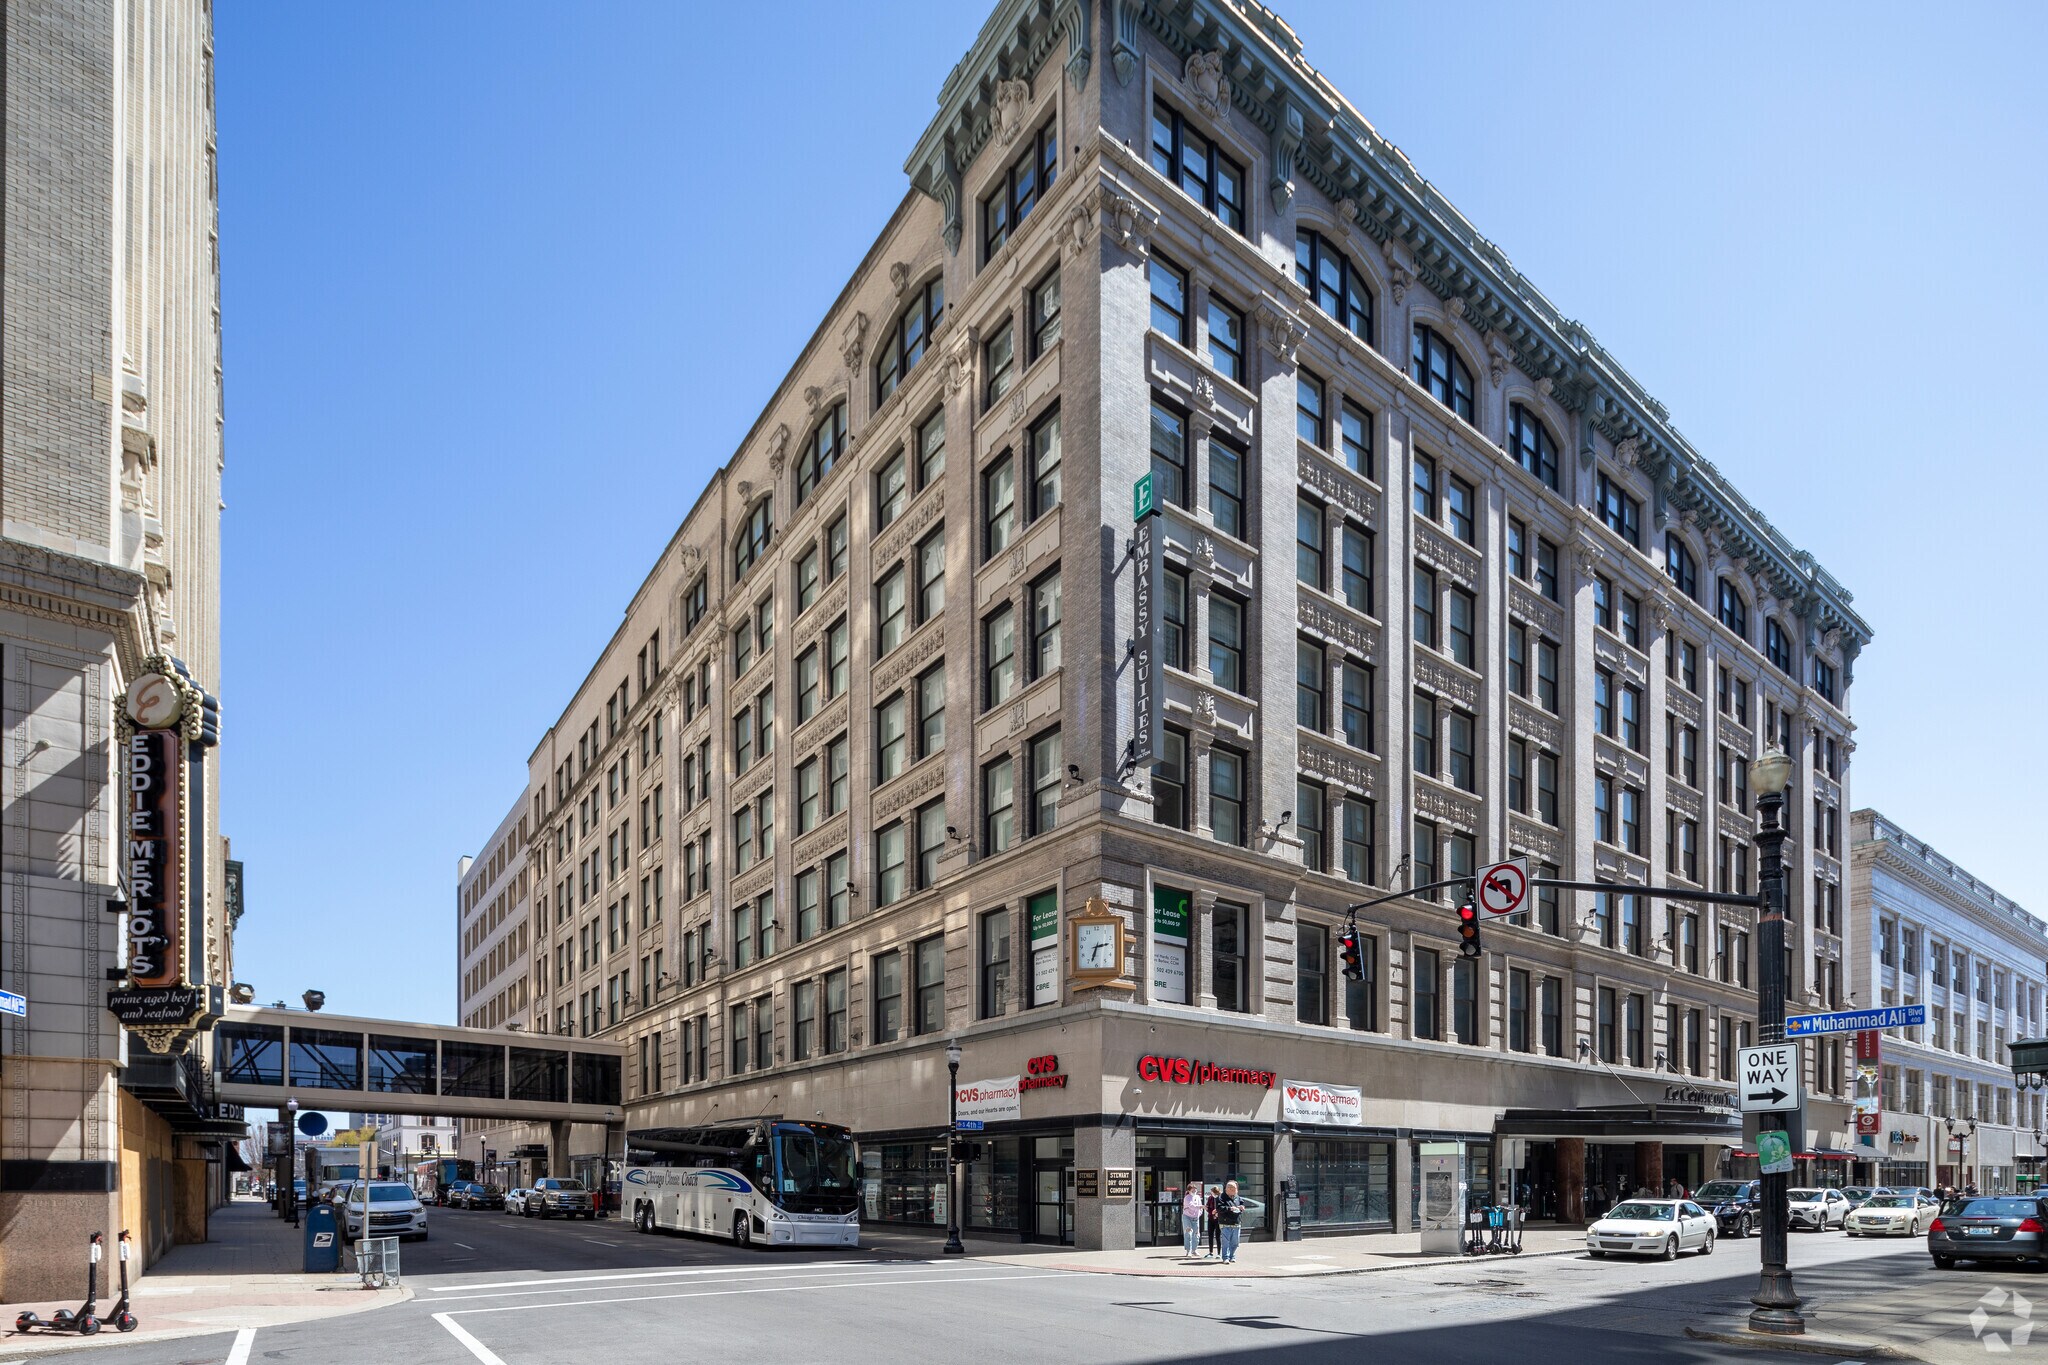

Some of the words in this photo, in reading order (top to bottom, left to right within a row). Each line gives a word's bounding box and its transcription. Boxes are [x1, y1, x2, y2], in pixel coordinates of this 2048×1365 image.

[1136, 525, 1150, 638] EMBASSY
[1137, 649, 1150, 745] SUITES
[131, 735, 151, 830] EDDIE
[130, 841, 156, 974] MERLOT'S
[1042, 910, 1057, 920] Lease
[1162, 908, 1180, 919] Lease
[1036, 982, 1050, 991] CBRE
[1154, 980, 1167, 988] BRE
[110, 995, 142, 1007] prime
[144, 993, 169, 1006] aged
[171, 991, 193, 1004] beef
[122, 1007, 143, 1019] and
[144, 1005, 185, 1021] seafood
[1802, 1020, 1810, 1030] W
[1813, 1011, 1886, 1031] Muhammad
[1889, 1009, 1906, 1025] Ali
[1908, 1008, 1923, 1016] Blvd
[1027, 1055, 1057, 1075] CVS
[1748, 1050, 1787, 1067] ONE
[1137, 1055, 1276, 1090] CVS/pharmacy
[1747, 1068, 1788, 1085] WAY
[1018, 1075, 1067, 1093] pharmacy
[960, 1088, 979, 1103] CVS
[980, 1087, 1018, 1103] pharmacy
[1298, 1088, 1320, 1103] CVS
[1321, 1092, 1359, 1108] pharmacy
[646, 1170, 664, 1188] Chicago
[682, 1171, 698, 1186] Coach
